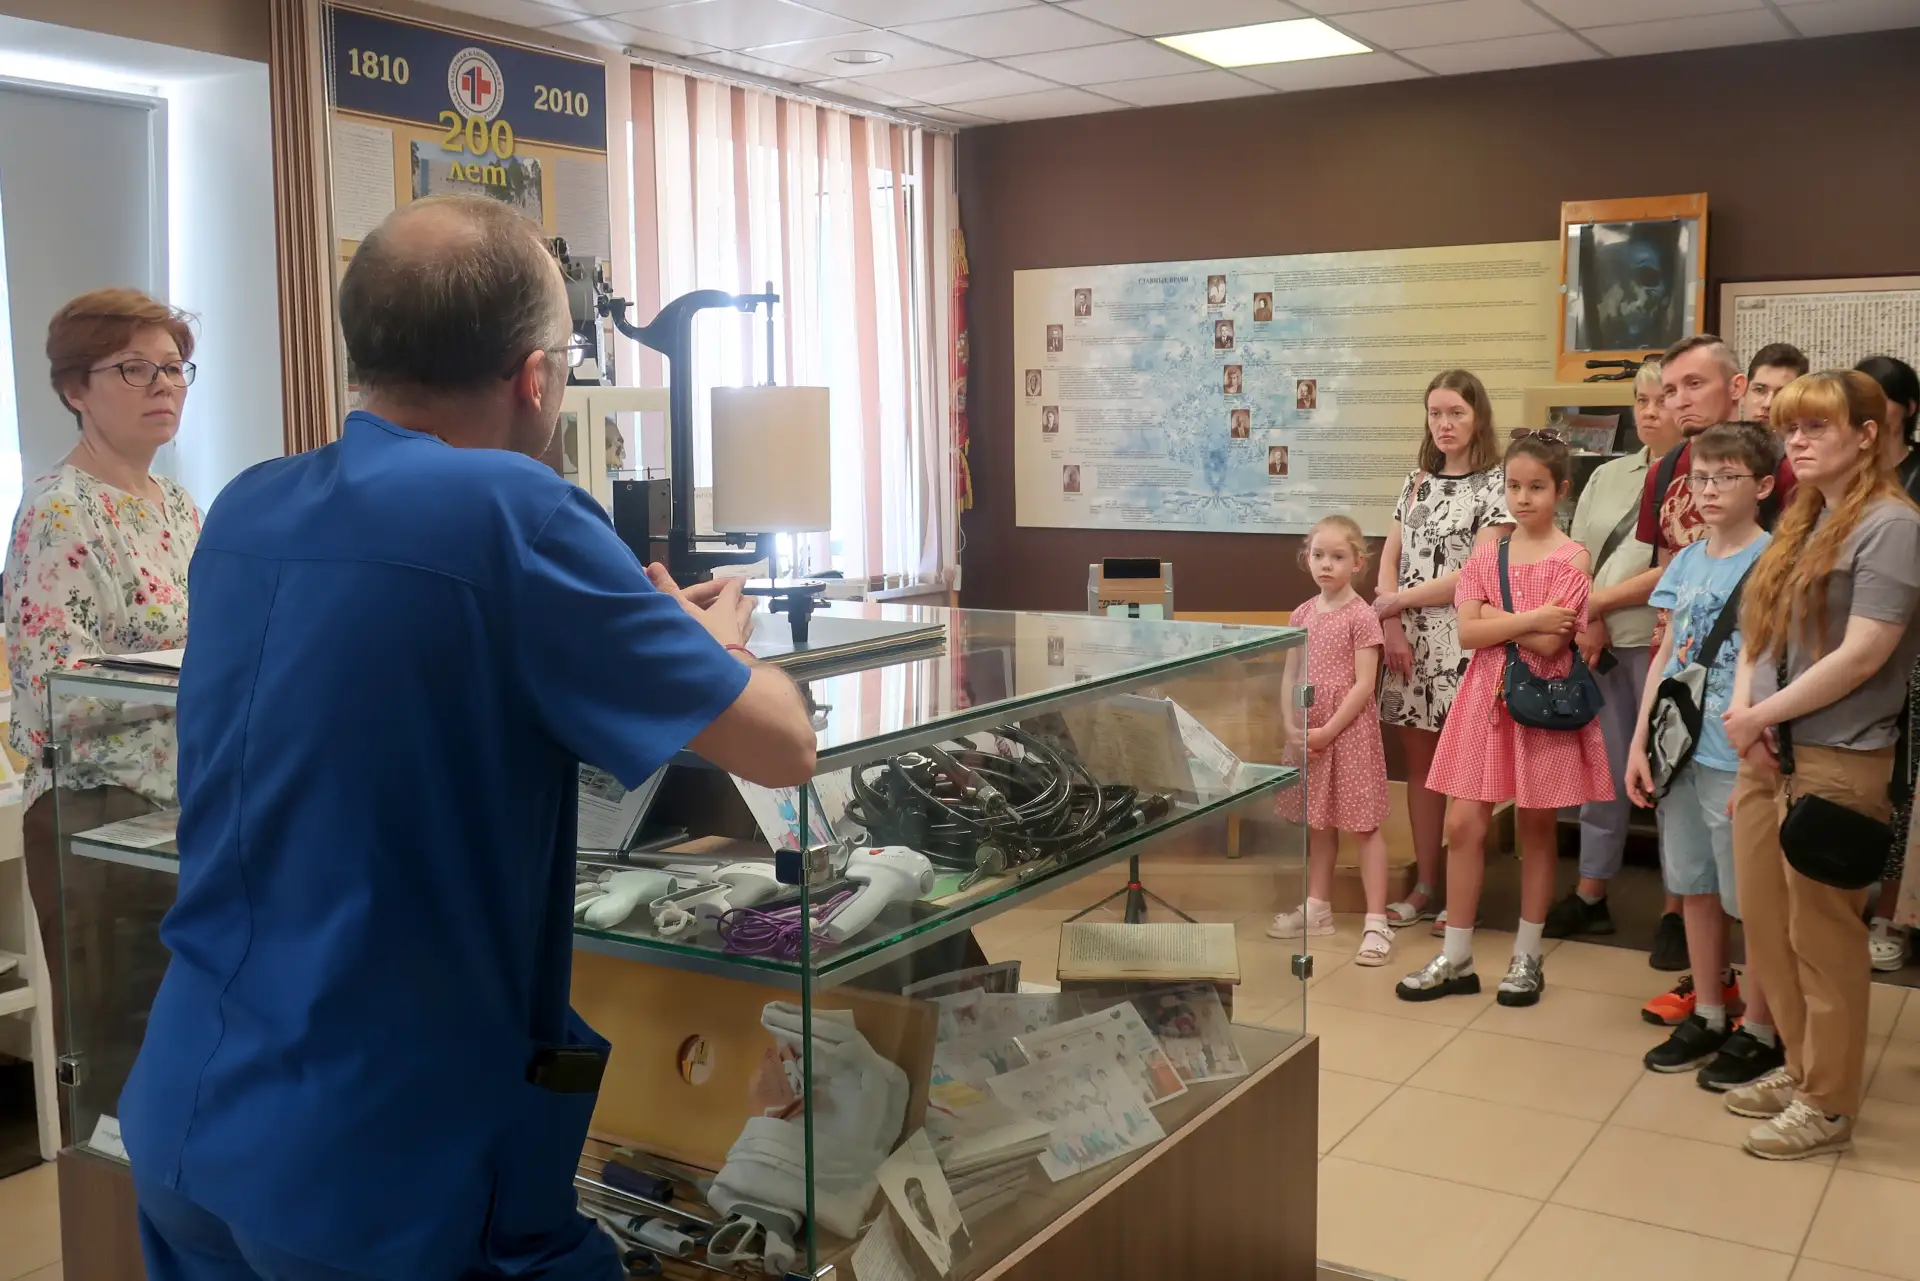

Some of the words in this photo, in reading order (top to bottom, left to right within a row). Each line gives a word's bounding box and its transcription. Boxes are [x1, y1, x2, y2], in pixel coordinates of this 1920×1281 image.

[348, 48, 410, 85] 1810
[534, 85, 590, 117] 2010
[438, 111, 515, 160] 200
[450, 160, 508, 188] лет
